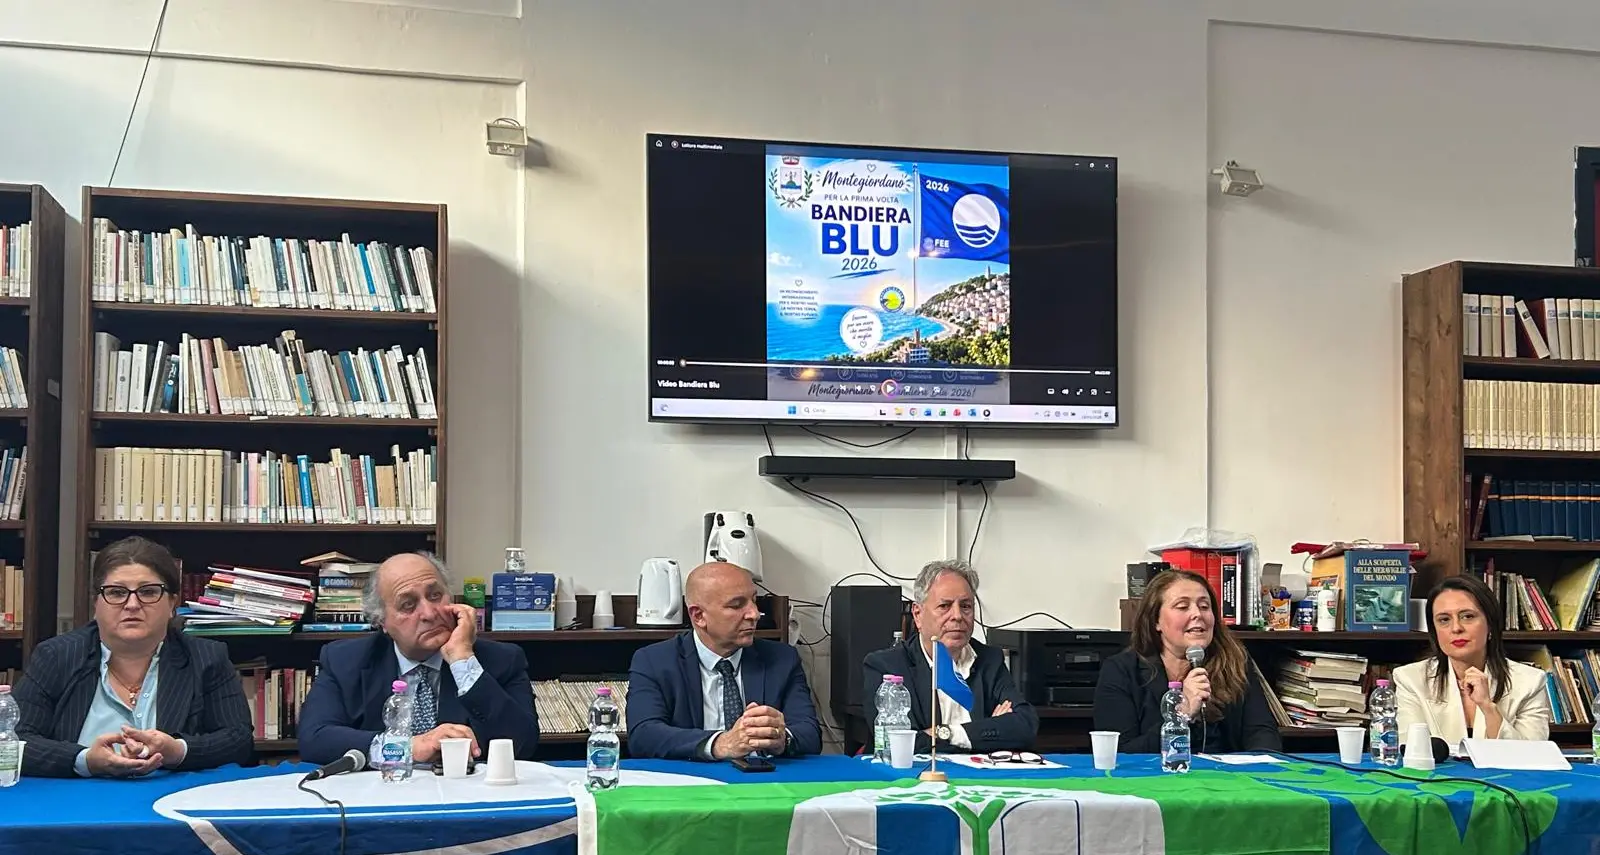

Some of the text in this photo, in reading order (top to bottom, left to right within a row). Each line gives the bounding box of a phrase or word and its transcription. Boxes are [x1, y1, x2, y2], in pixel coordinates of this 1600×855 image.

[822, 169, 905, 194] Montegiordano
[925, 180, 950, 192] 2026
[824, 193, 899, 204] PER LA PRIMA VOLTA
[811, 204, 912, 224] BANDIERA
[822, 222, 899, 257] BLU
[934, 238, 950, 248] FEE
[841, 256, 878, 271] 2026
[657, 380, 720, 389] Video Bandiera Blu
[1357, 558, 1372, 566] ALLA
[1353, 566, 1407, 574] DELLE MERAVIGLIE
